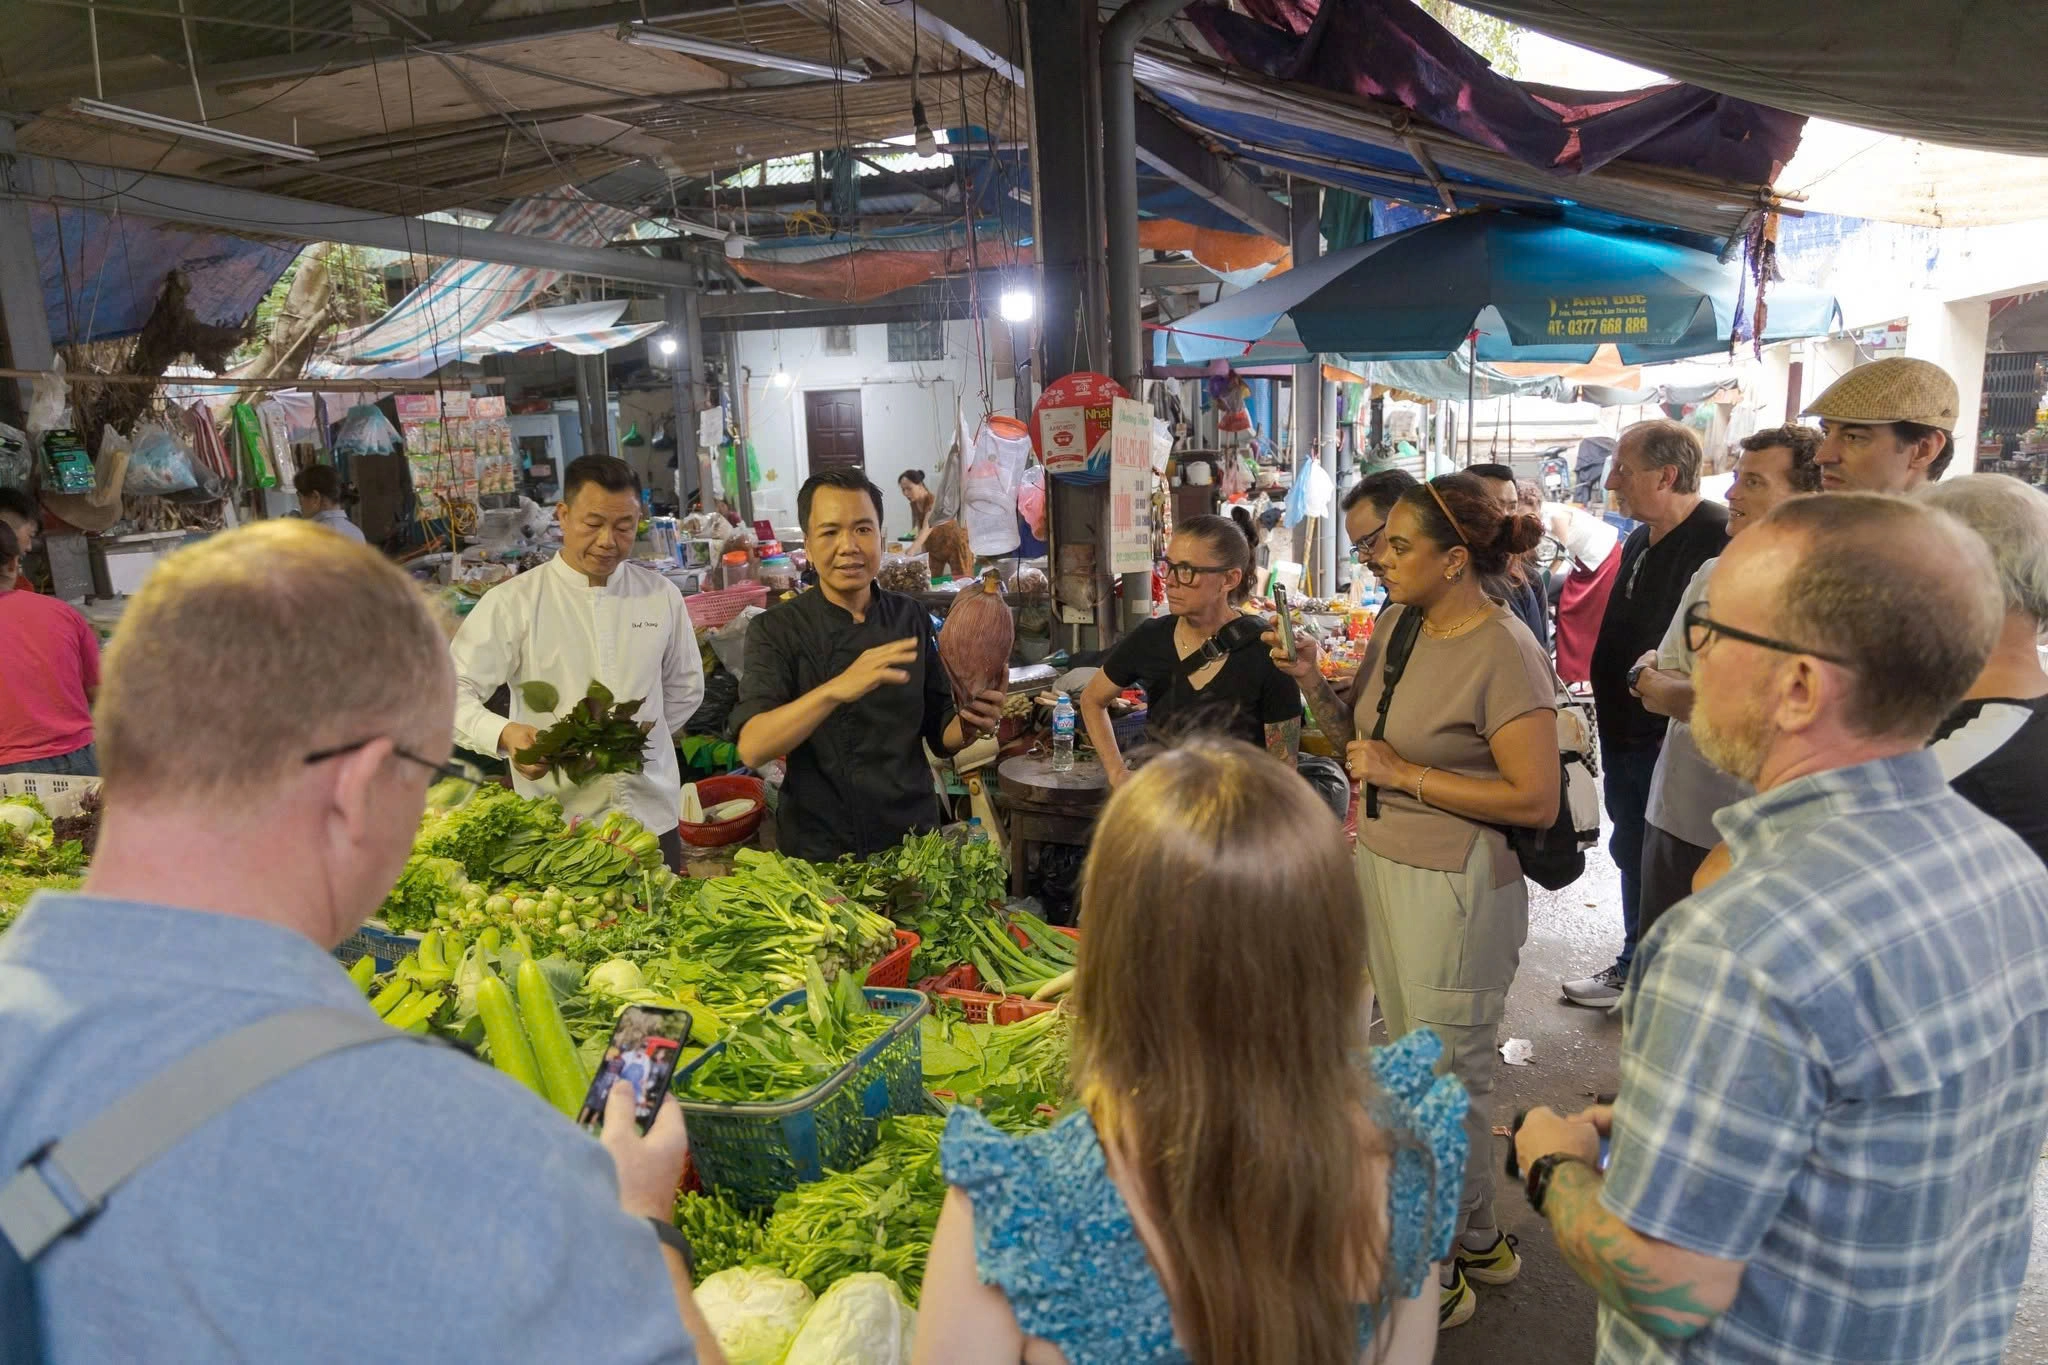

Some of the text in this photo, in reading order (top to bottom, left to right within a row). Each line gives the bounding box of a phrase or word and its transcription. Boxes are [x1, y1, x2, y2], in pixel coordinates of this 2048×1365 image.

[1567, 318, 1597, 336] 0377
[1600, 317, 1622, 335] 668
[1625, 316, 1648, 334] 889
